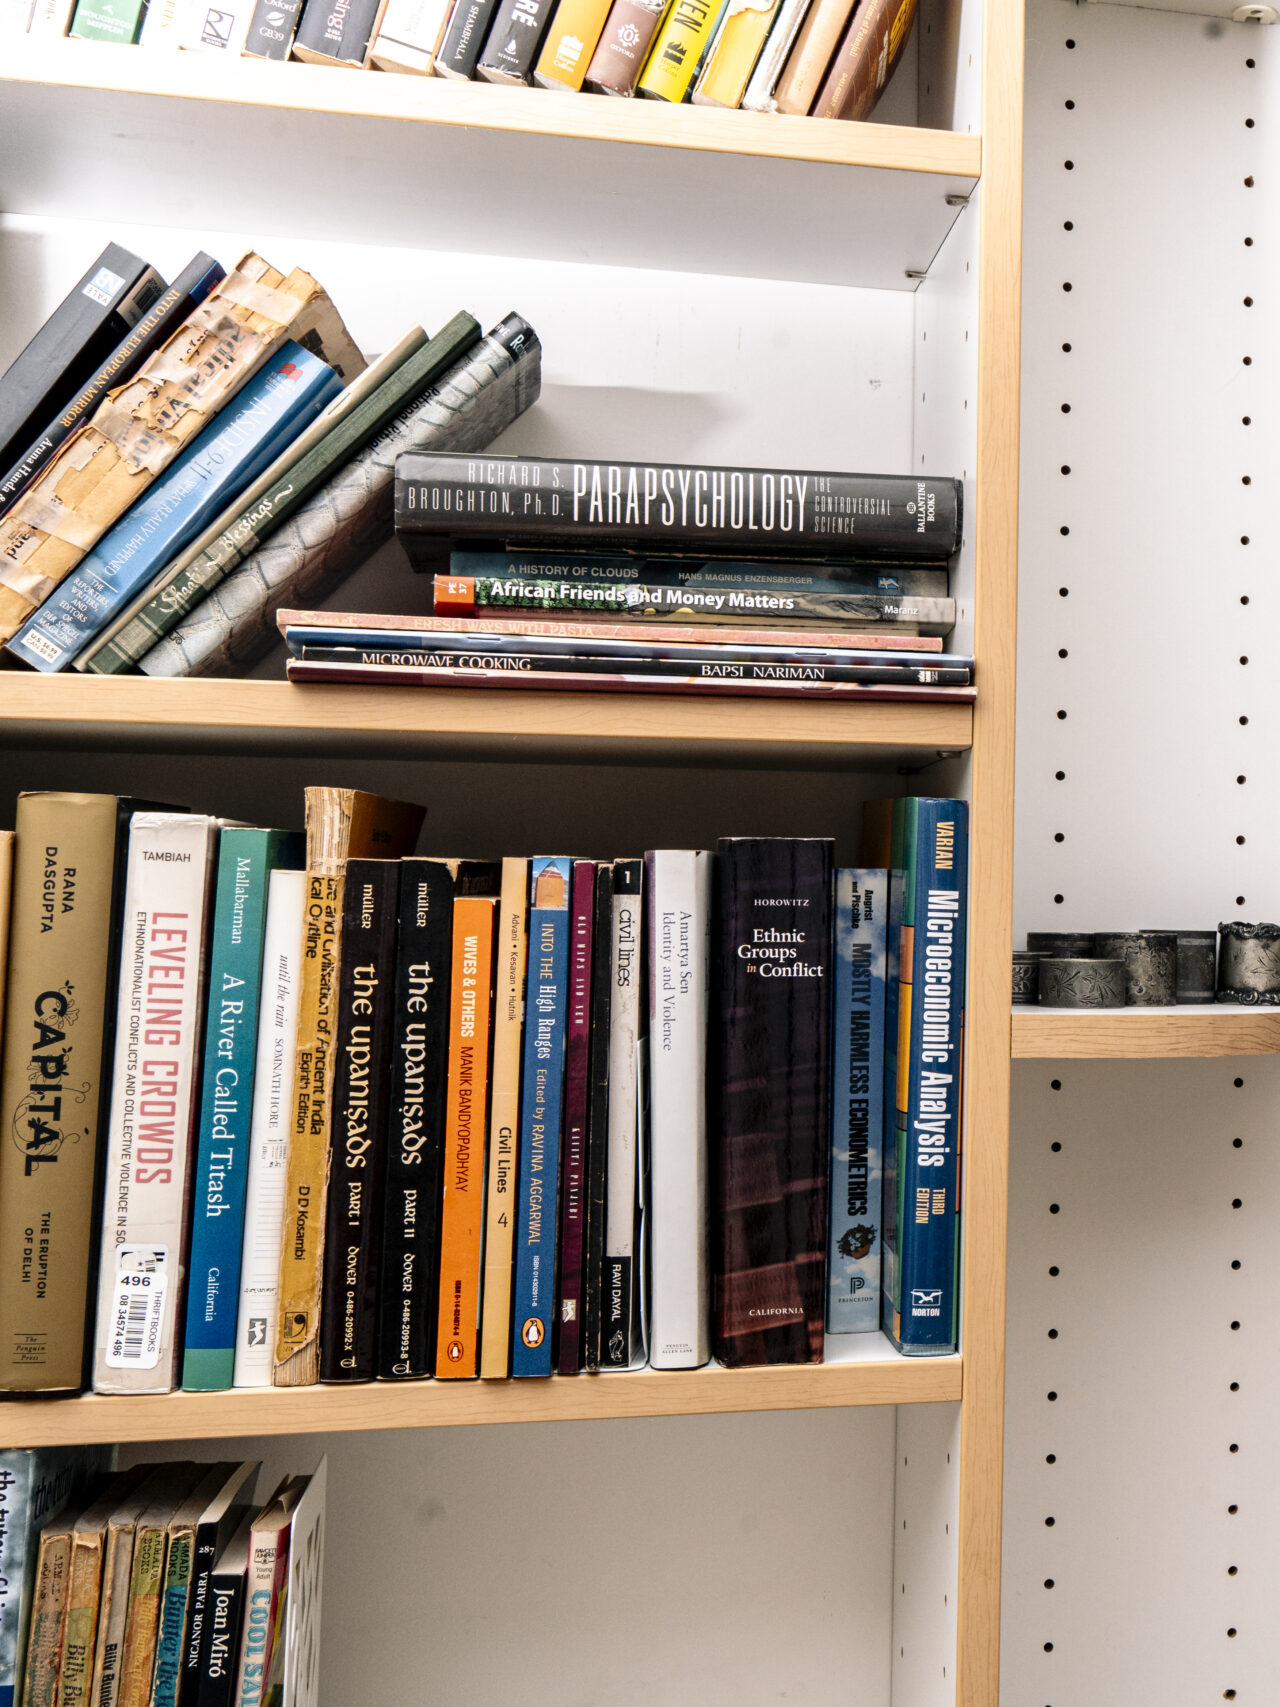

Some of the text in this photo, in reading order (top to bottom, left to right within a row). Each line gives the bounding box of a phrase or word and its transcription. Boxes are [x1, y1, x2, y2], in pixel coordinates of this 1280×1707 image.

[87, 19, 125, 35] MIFFLIN
[454, 6, 480, 60] SHAMBHALA
[83, 286, 110, 307] YALE
[157, 289, 182, 318] INTO
[99, 331, 142, 386] EUROPEAN
[60, 383, 100, 428] MIRROR
[104, 393, 272, 577] INSIDE 9-11 WHAT REALLY HAPPENED
[468, 462, 565, 488] RICHARD S.
[814, 477, 831, 493] THE
[408, 487, 515, 516] BROUGHTON,
[573, 463, 809, 533] PARAPSYCHOLOGY
[814, 495, 891, 516] CONTROVERSIAL
[917, 482, 926, 533] BALLANTINE
[927, 493, 935, 522] BOOKS
[814, 516, 855, 535] SCIENCE
[90, 579, 106, 592] THE
[448, 582, 456, 594] PE
[508, 564, 639, 578] A HISTORY OF CLOUDS
[678, 571, 813, 584] HANS MAGNUS ENZENSBERGER
[59, 600, 88, 624] EDITORS
[70, 597, 88, 613] AND
[491, 582, 794, 611] African Friends and Money Matters
[884, 605, 919, 615] Maranz
[37, 617, 73, 646] MAGAZINE
[62, 612, 74, 624] OF
[414, 620, 594, 637] FRESH WAYS WITH PASTA
[362, 652, 531, 671] MICROWAVE COOKING
[701, 665, 826, 680] BAPSI NARIMAN
[142, 851, 191, 862] TAMBIAH
[935, 821, 955, 870] VARIAN
[41, 847, 58, 934] DASGUPTA
[62, 868, 76, 914] RANA
[232, 857, 251, 944] Mallabarman
[851, 881, 862, 929] and Pischke
[863, 889, 874, 921] Angrist
[617, 909, 635, 987] civil lines
[676, 911, 693, 994] Amartya Sen
[737, 944, 798, 963] Groups
[753, 929, 806, 943] Ethnic
[131, 911, 147, 1013] ETHNONATIONALIST
[278, 955, 291, 984] until
[507, 914, 521, 1021] Advani Kesavan Hutnik
[660, 912, 676, 1051] Identity and Violence
[746, 963, 824, 977] in Conflict
[276, 986, 290, 1001] the
[461, 936, 478, 1037] WIVES & OTHERS
[274, 1005, 287, 1028] rain
[914, 889, 959, 1167] Microeconomic Analysis
[127, 1015, 140, 1071] CONFLICTS
[135, 912, 188, 1184] LEVELING CROWDS
[24, 989, 68, 1177] CAPITAL
[125, 1073, 137, 1096] AND
[271, 1037, 285, 1095] SOMNATH
[528, 923, 557, 1246] INTO THE High Ranges Edited by RAVINA AGGARWAL
[847, 943, 872, 1216] MOSTLY HARMLESS ECONOMETRICS
[206, 973, 246, 1218] A River Called Titash
[268, 1097, 281, 1128] HORE
[296, 1053, 313, 1134] Eighth Edition
[121, 1099, 135, 1159] COLLECTIVE
[455, 1046, 474, 1193] MANIK BANDYOPADHYAY
[117, 1162, 130, 1213] VIOLENCE
[497, 1127, 512, 1228] Civil Lines 4
[116, 1216, 127, 1227] IN
[915, 1188, 930, 1224] EDITION
[932, 1188, 946, 1215] THIRD
[294, 1186, 310, 1260] D D Kosambi
[22, 1228, 34, 1283] OF DELHI
[37, 1212, 51, 1299] THE ERUPTION
[121, 1276, 151, 1286] 496
[205, 1267, 221, 1322] California
[610, 1264, 622, 1322] RAVI DAYAL
[113, 1294, 129, 1356] 08 34574 496
[147, 1290, 163, 1352] THRIFTBOOKS
[748, 1308, 804, 1317] CALIFORNIA
[912, 1308, 940, 1317] NORTON
[198, 1545, 215, 1555] 287
[188, 1571, 209, 1668] NICANOR PARRA
[208, 1588, 235, 1678] Joan Miró
